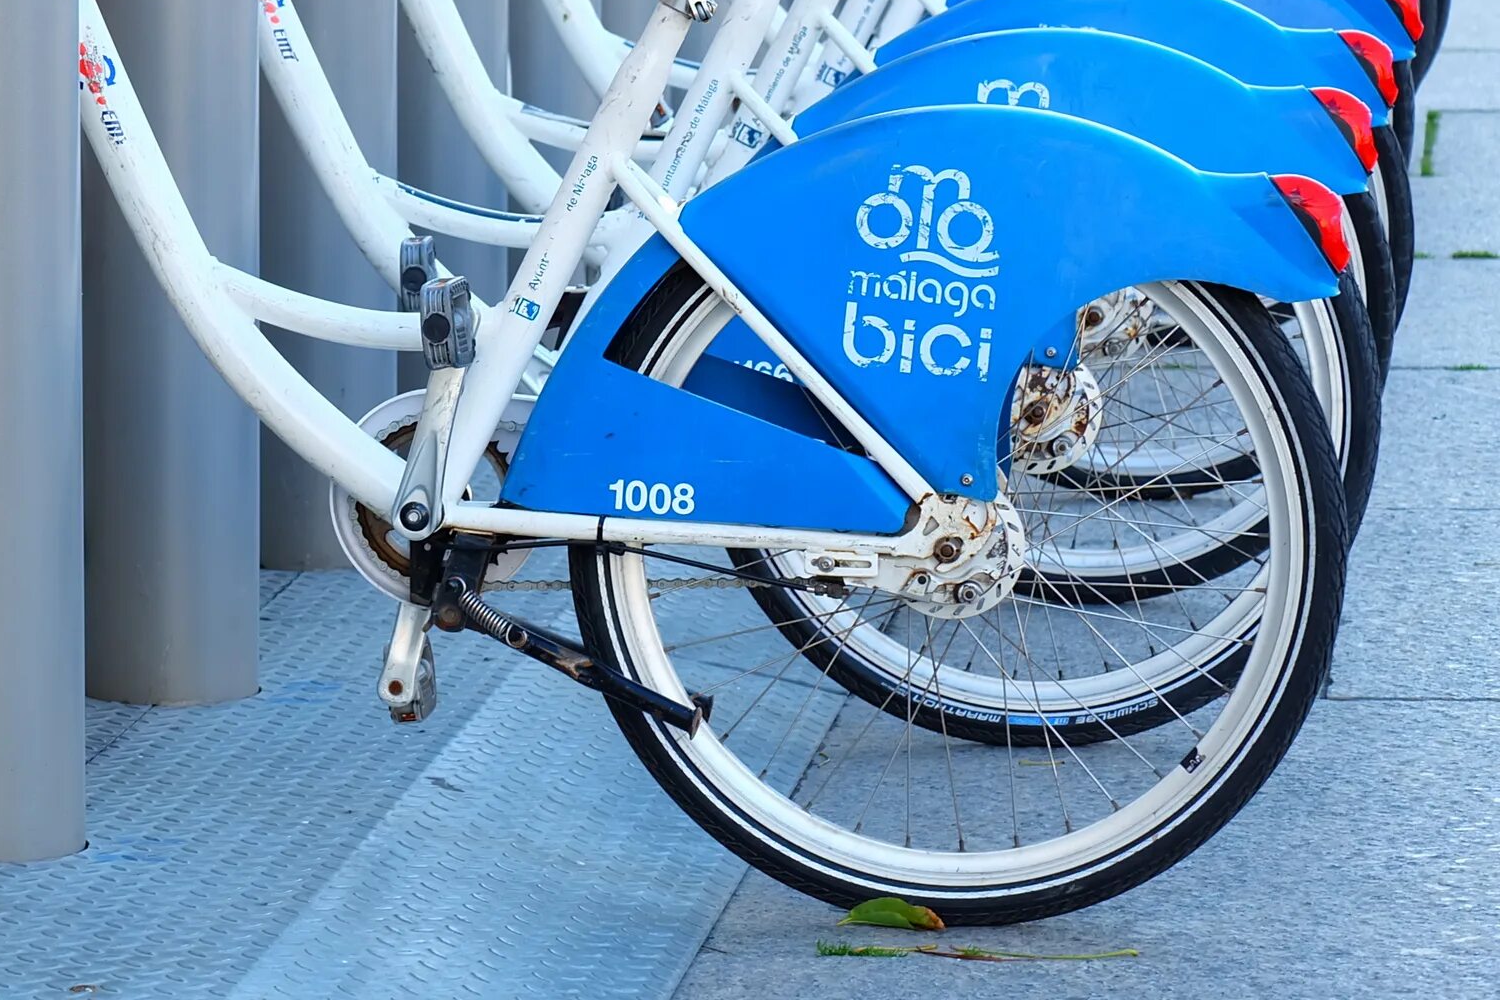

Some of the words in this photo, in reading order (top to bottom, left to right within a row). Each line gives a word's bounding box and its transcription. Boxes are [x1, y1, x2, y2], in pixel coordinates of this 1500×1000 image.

[690, 115, 701, 131] de
[849, 269, 997, 319] málaga
[842, 300, 993, 383] bici
[609, 479, 695, 515] 1008
